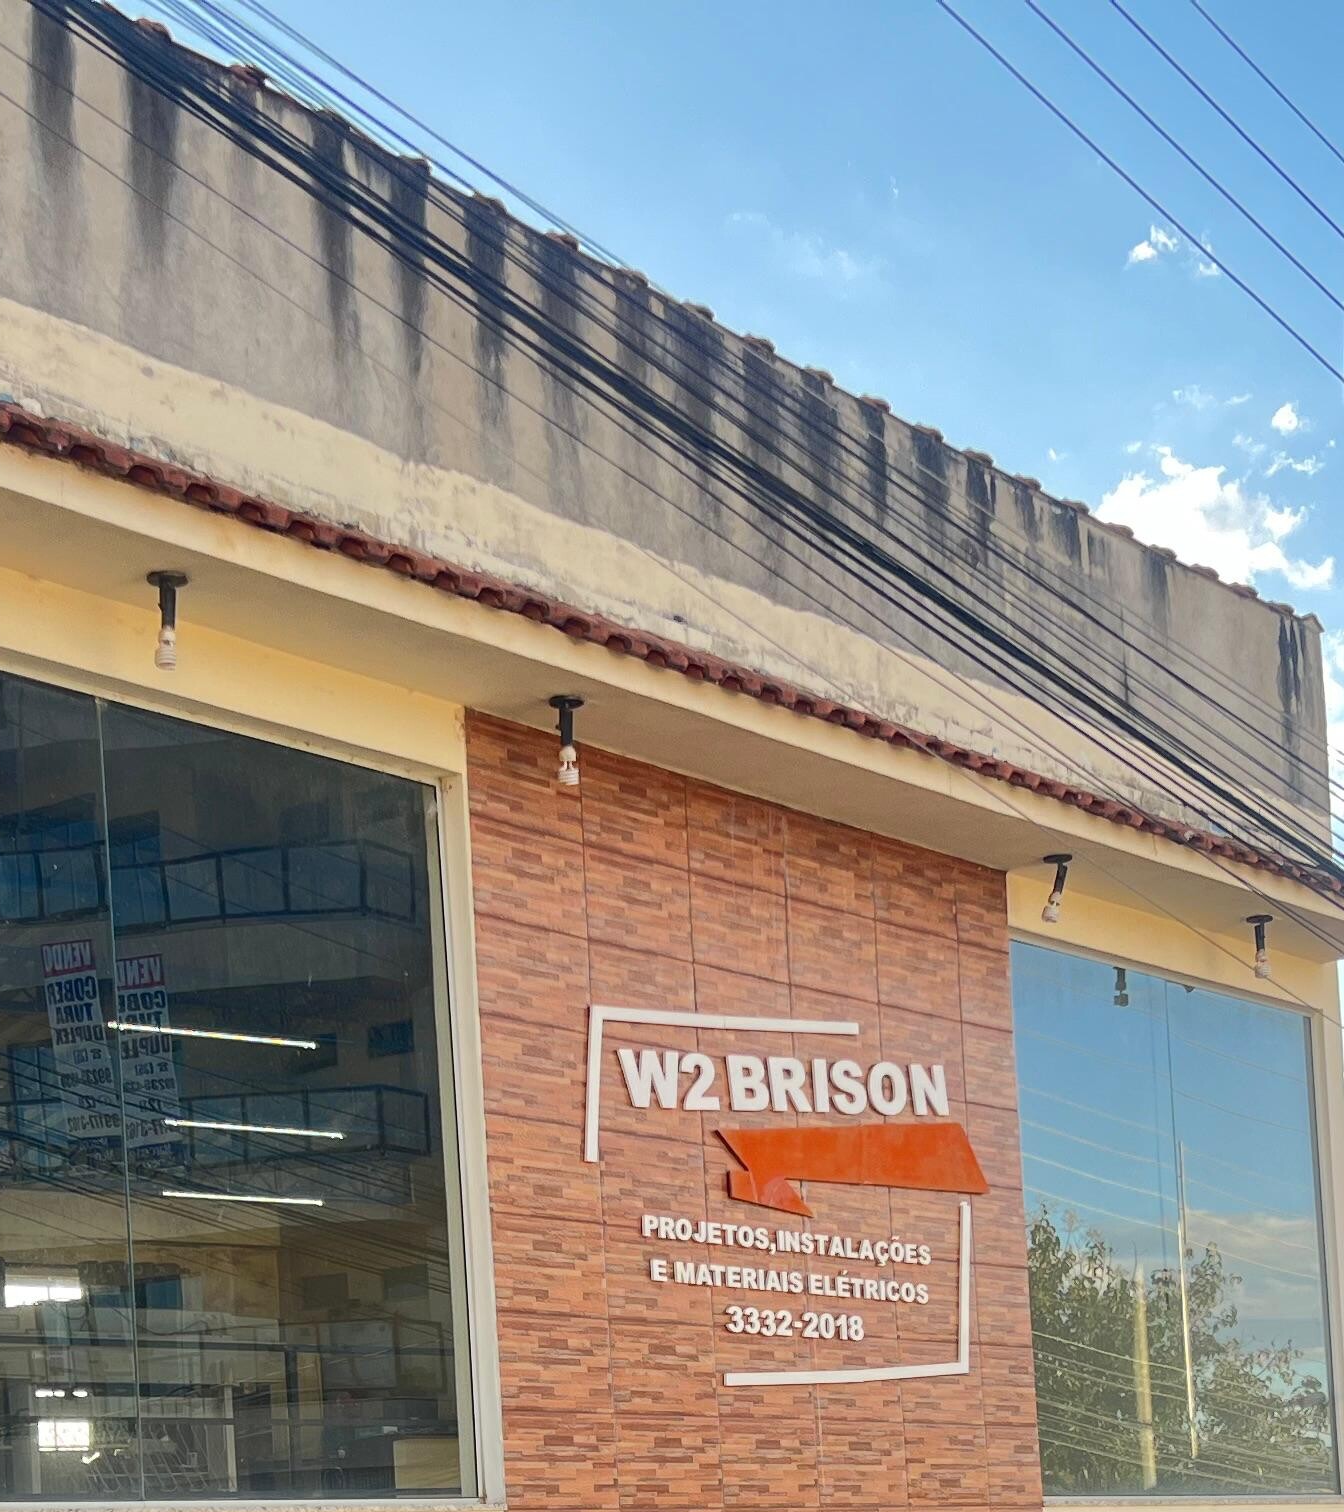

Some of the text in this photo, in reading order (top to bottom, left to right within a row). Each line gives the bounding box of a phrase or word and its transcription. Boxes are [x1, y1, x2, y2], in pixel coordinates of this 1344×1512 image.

[617, 1048, 951, 1117] W2 BRISON
[650, 1258, 930, 1305] E MATERIAIS ELÉTRICOS
[725, 1305, 865, 1341] 3332-2018
